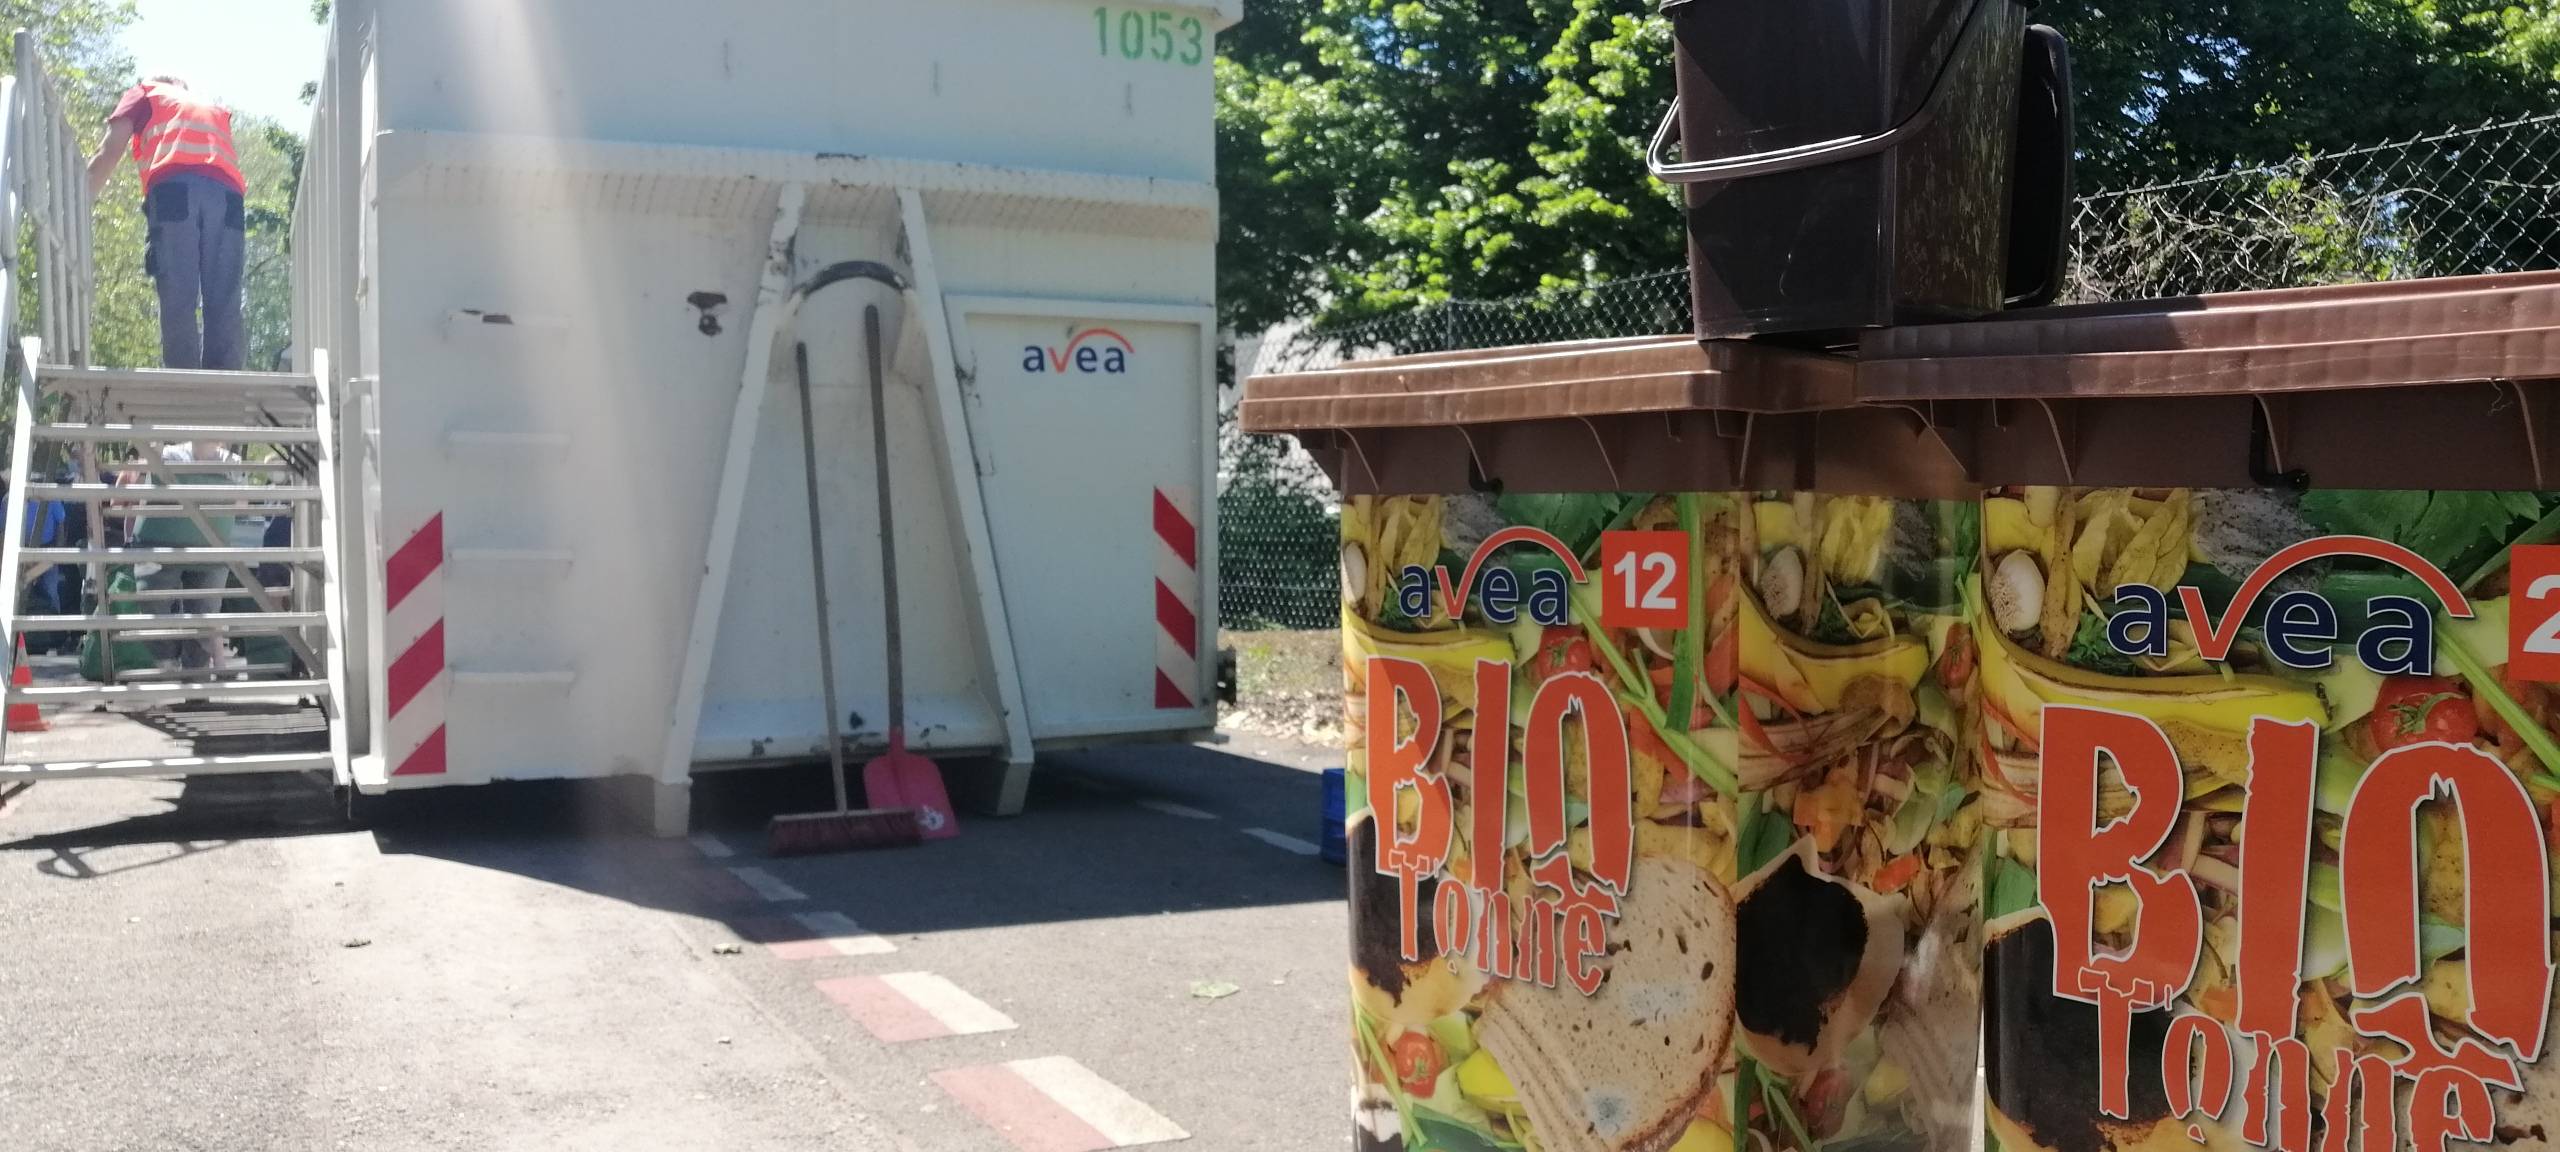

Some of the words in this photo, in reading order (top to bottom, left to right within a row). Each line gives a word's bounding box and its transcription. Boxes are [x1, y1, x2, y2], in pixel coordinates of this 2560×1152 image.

[1094, 7, 1203, 66] 1053
[1022, 328, 1134, 375] avea
[1399, 527, 1587, 625] avea
[1612, 551, 1677, 609] 12
[2106, 535, 2474, 676] avea
[1365, 656, 1634, 905] BIO
[2037, 704, 2555, 1072] BIO
